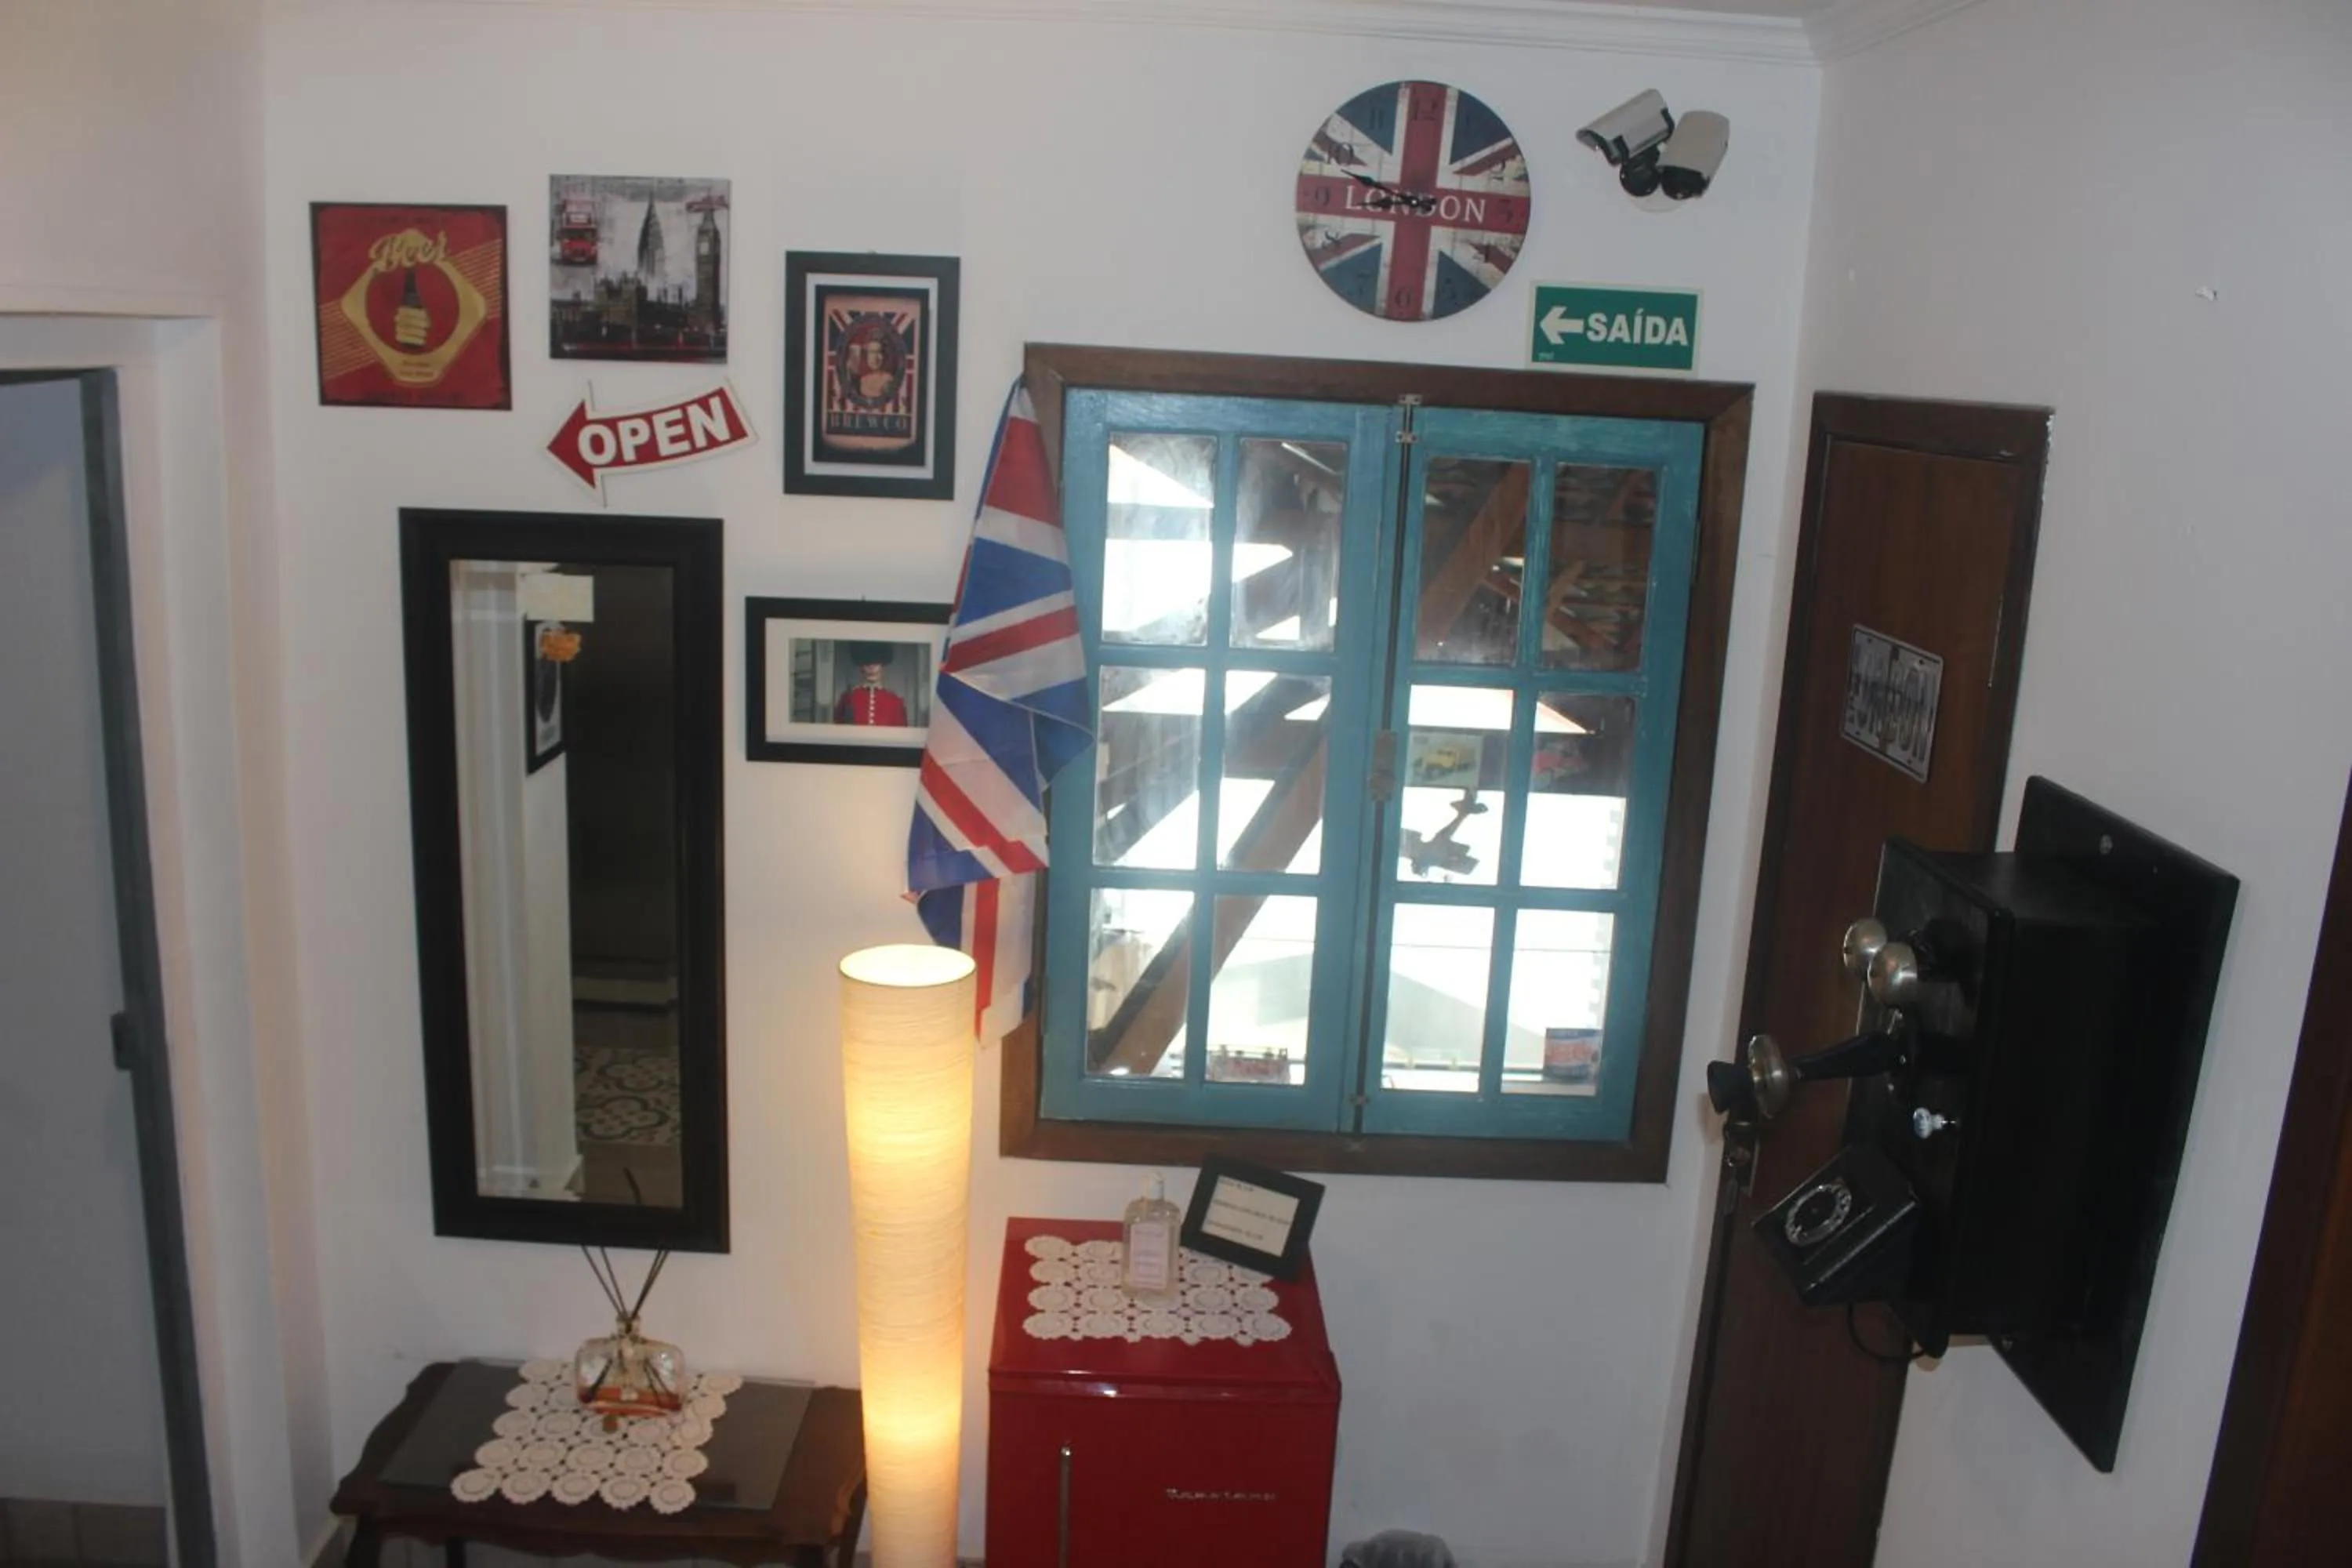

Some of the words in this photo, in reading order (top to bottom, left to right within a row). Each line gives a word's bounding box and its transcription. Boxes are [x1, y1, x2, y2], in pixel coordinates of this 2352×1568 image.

[1410, 97, 1438, 122] 12
[1315, 186, 1331, 207] 9
[1345, 185, 1486, 223] LONDON
[1395, 285, 1412, 308] 6
[1587, 308, 1688, 346] SAÍDA
[578, 396, 730, 465] OPEN
